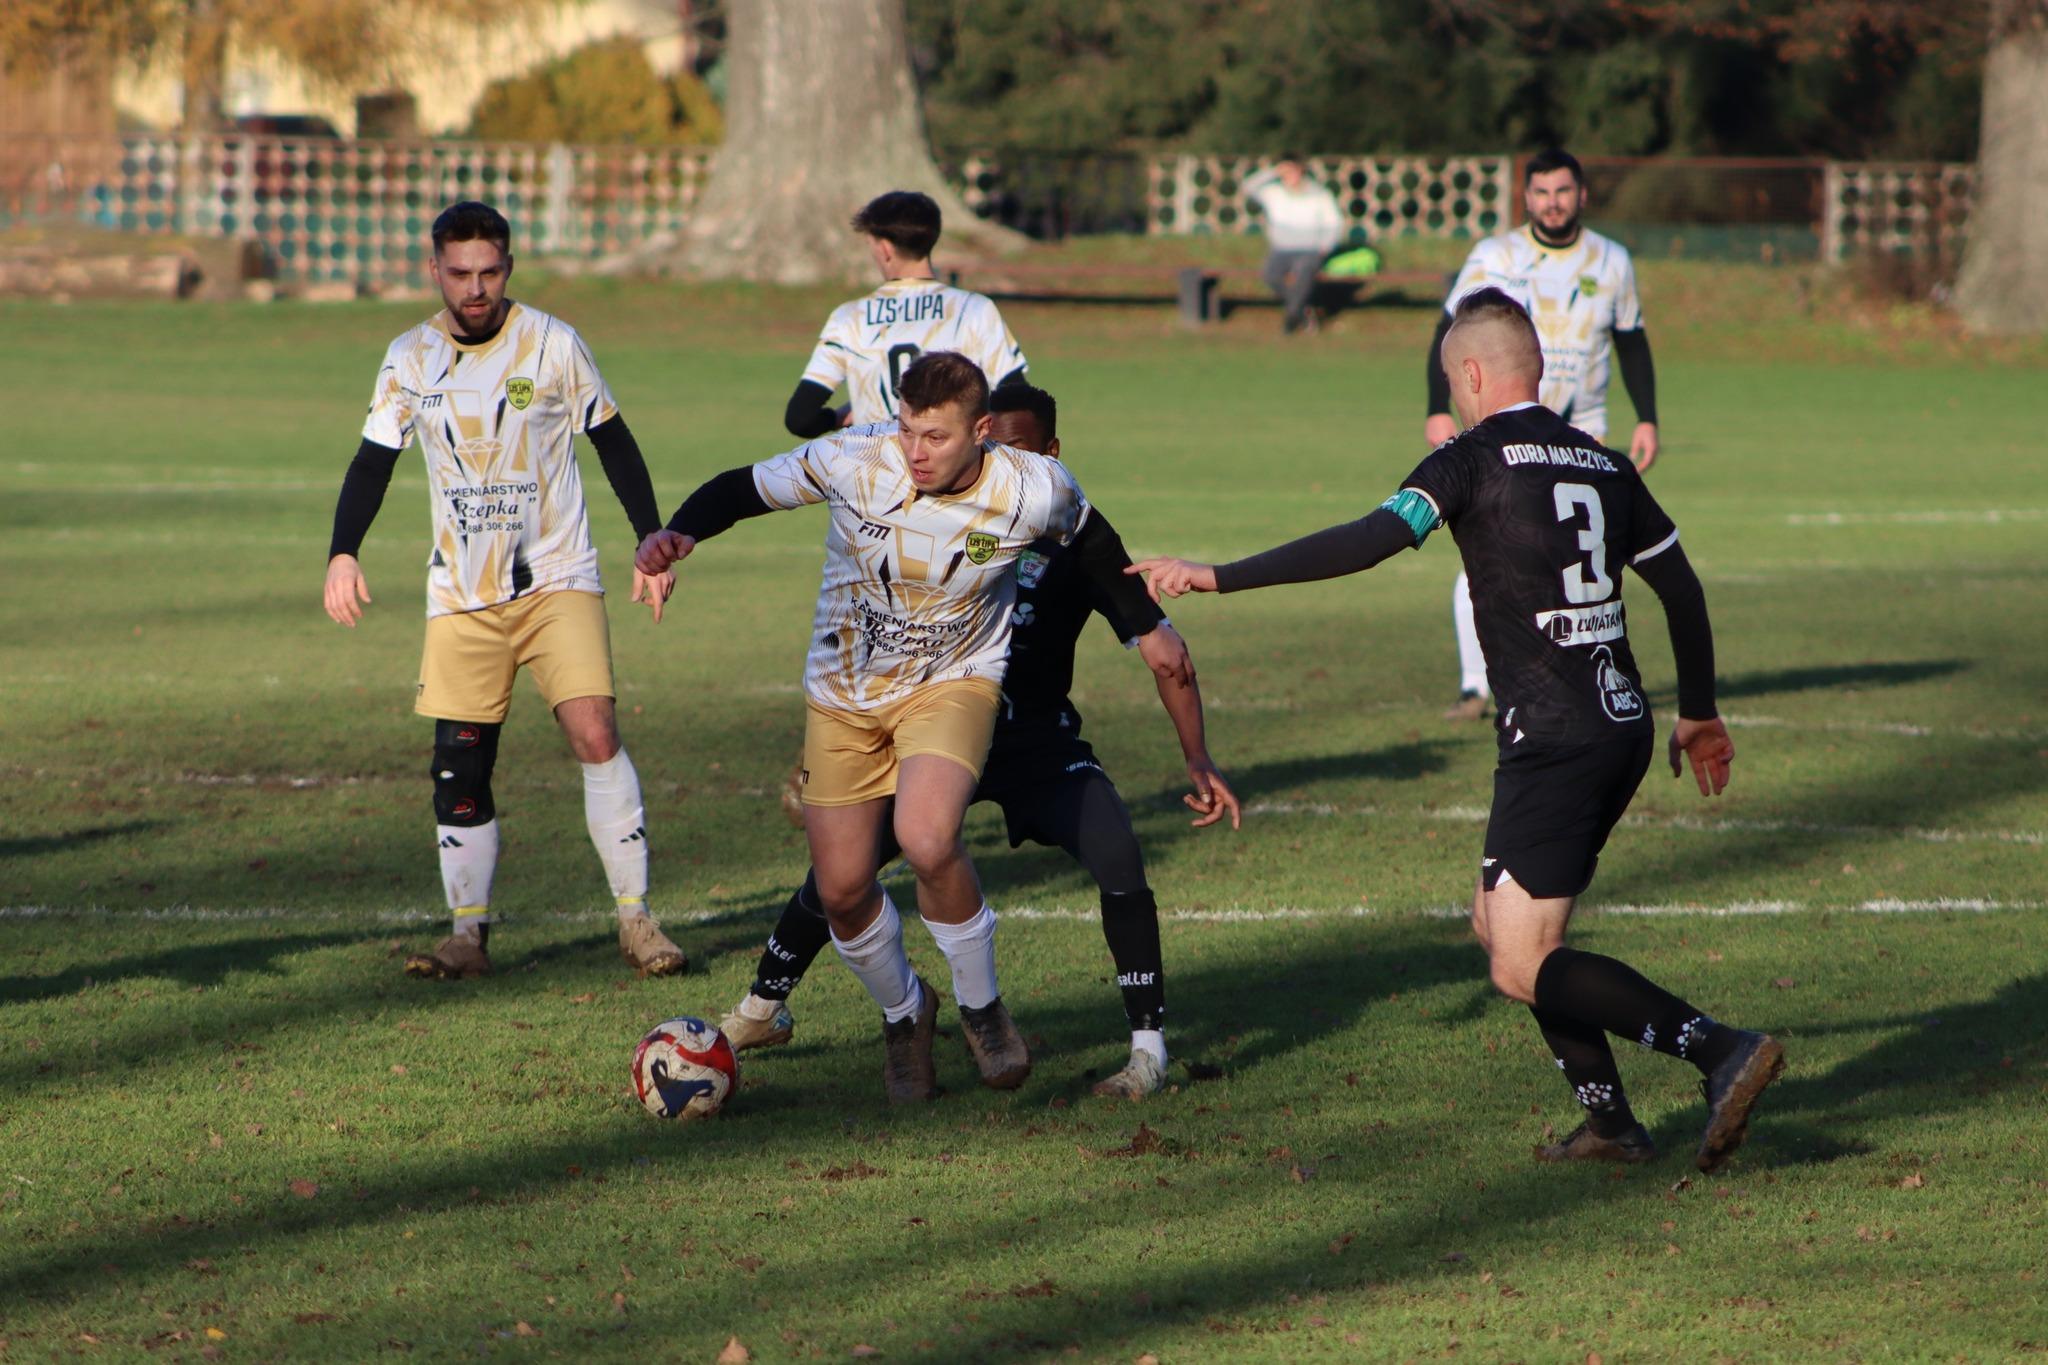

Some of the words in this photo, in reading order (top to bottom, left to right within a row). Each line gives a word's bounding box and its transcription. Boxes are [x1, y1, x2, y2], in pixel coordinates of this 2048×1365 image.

[867, 297, 897, 326] LZS
[904, 294, 944, 322] LIPA
[1502, 443, 1549, 466] ODRA
[1547, 444, 1618, 472] MALCZYCE
[506, 521, 524, 531] 266
[1553, 482, 1614, 604] 3
[1611, 692, 1639, 712] ABC
